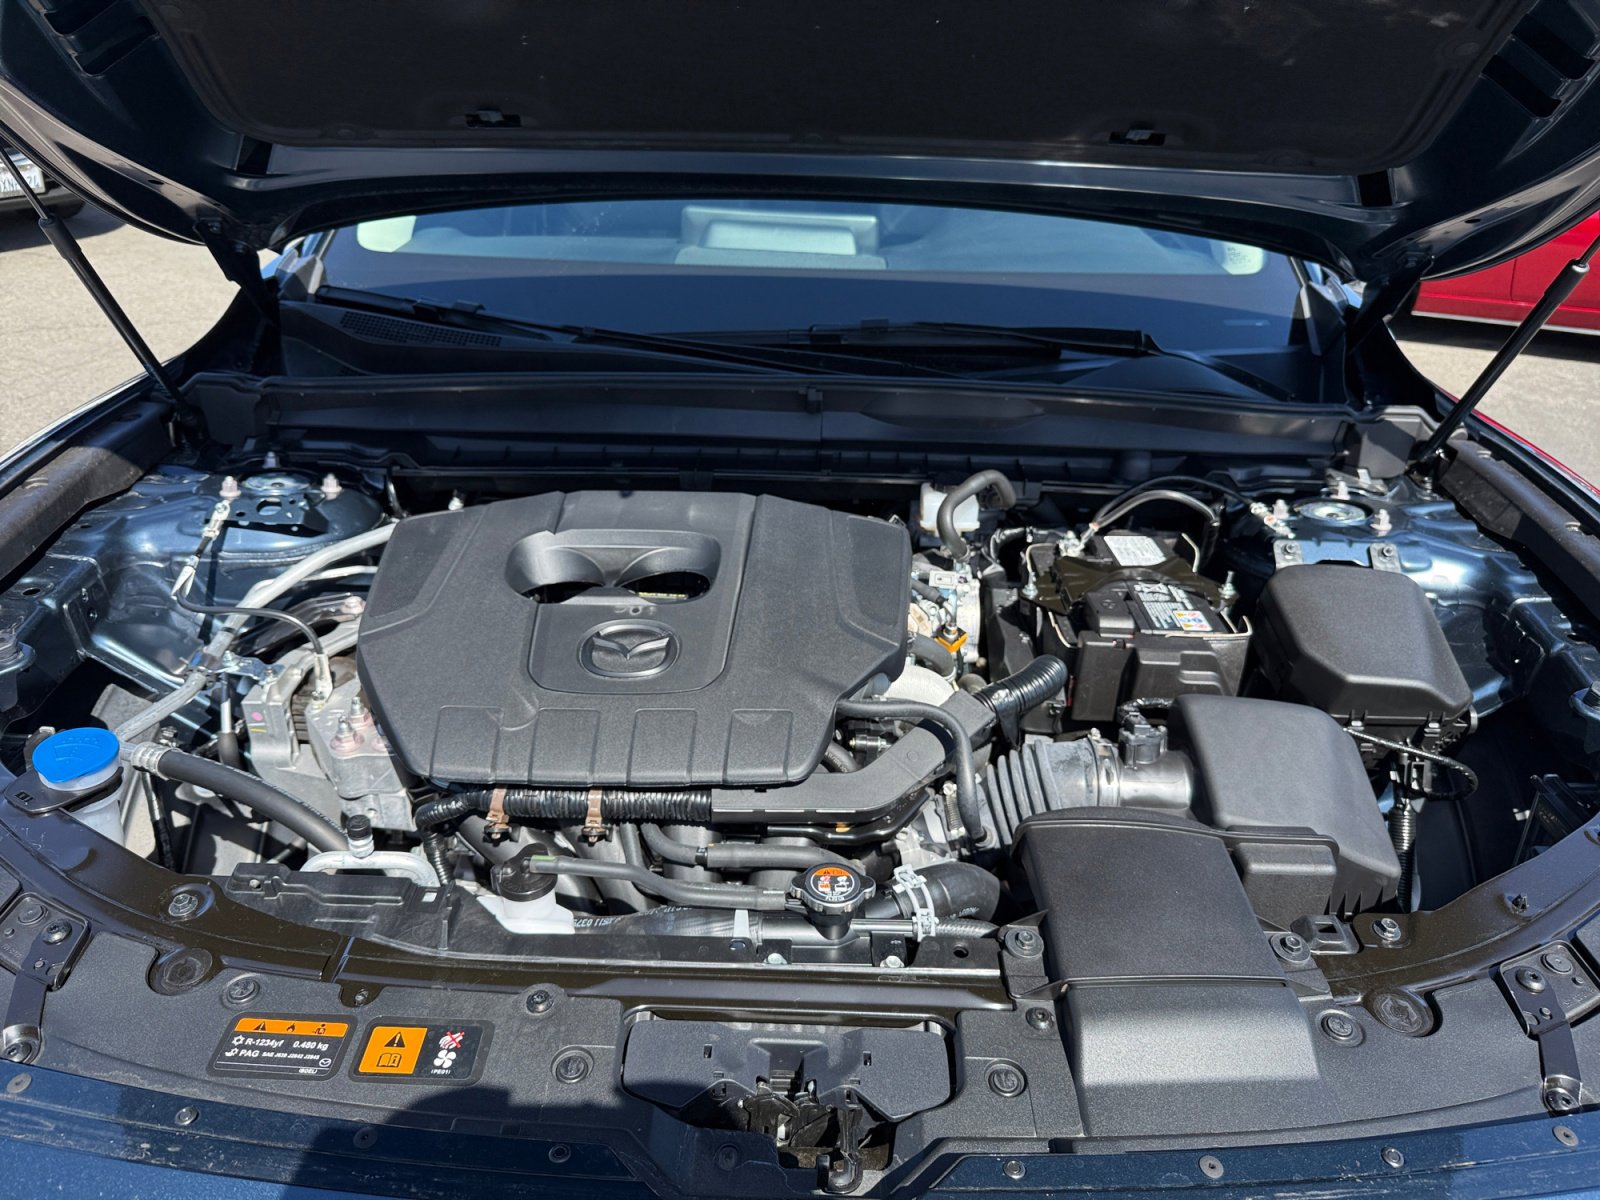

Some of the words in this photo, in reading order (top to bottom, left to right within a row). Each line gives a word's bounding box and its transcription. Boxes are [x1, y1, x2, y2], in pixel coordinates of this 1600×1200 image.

[245, 1038, 284, 1048] R-1234yf
[293, 1040, 316, 1049] 0.480
[317, 1041, 329, 1051] kg
[239, 1049, 260, 1058] PAG
